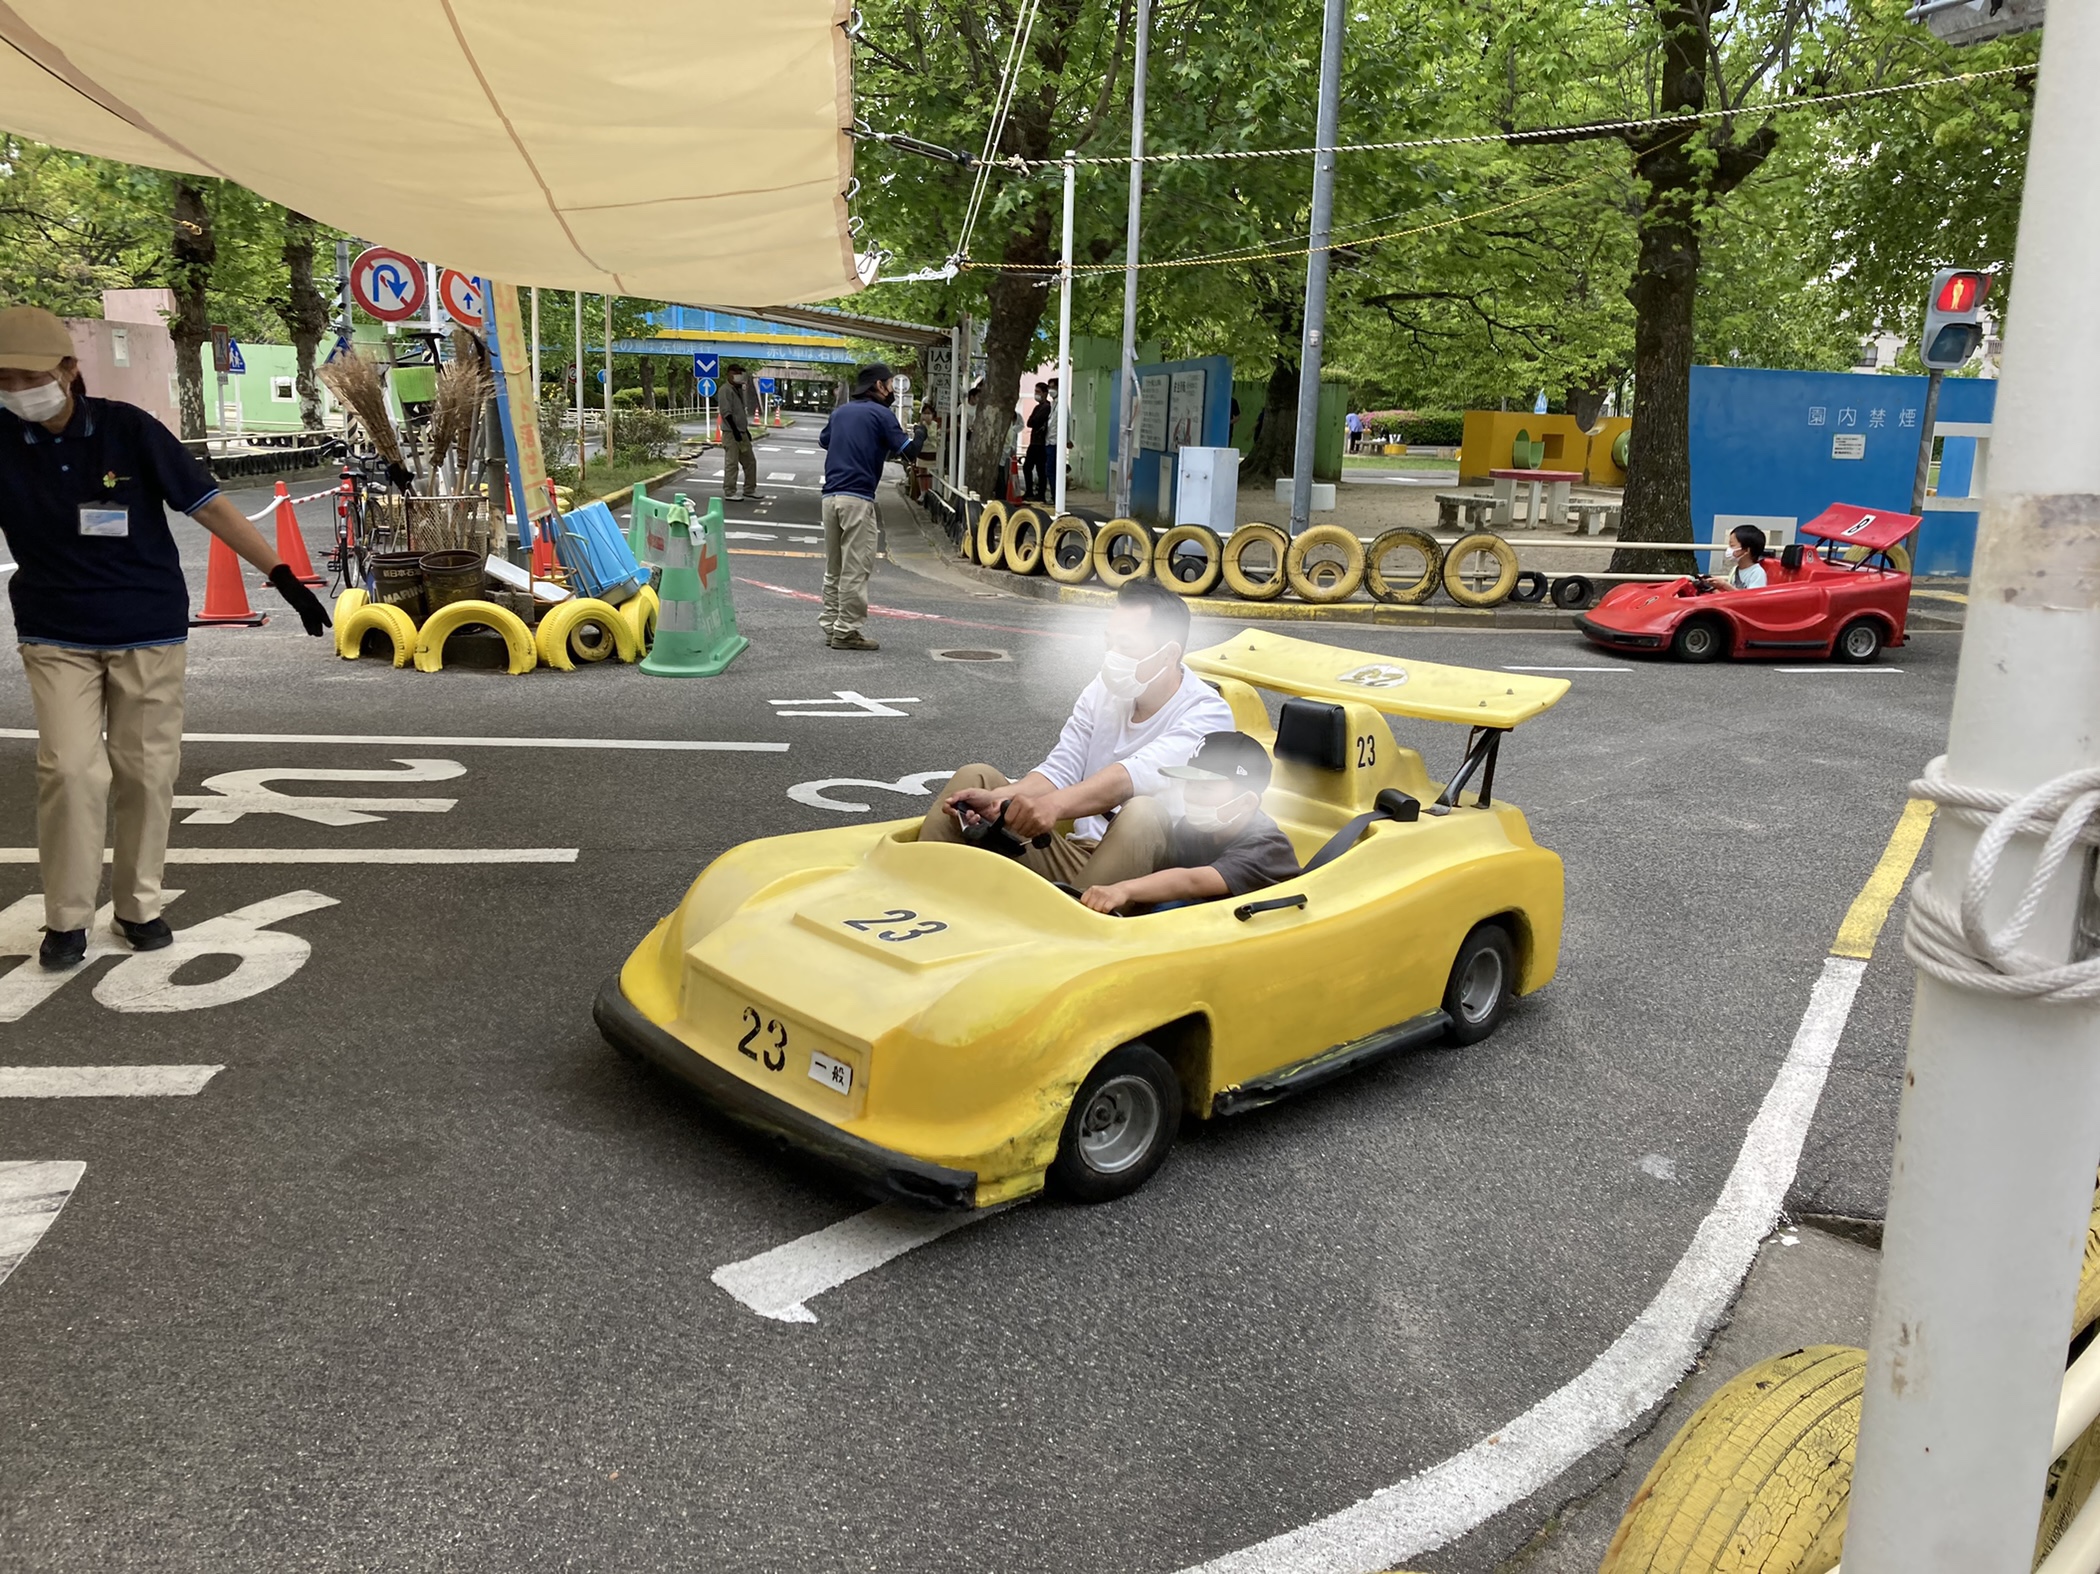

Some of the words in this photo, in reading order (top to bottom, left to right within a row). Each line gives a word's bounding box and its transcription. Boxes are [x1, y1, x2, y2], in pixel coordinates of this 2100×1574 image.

[1808, 406, 1917, 429] 園内禁煙
[1847, 518, 1870, 534] 8
[1807, 551, 1814, 562] 8
[1356, 735, 1376, 768] 23
[842, 909, 948, 942] 23
[737, 1006, 788, 1072] 23
[814, 1060, 845, 1086] 一般
